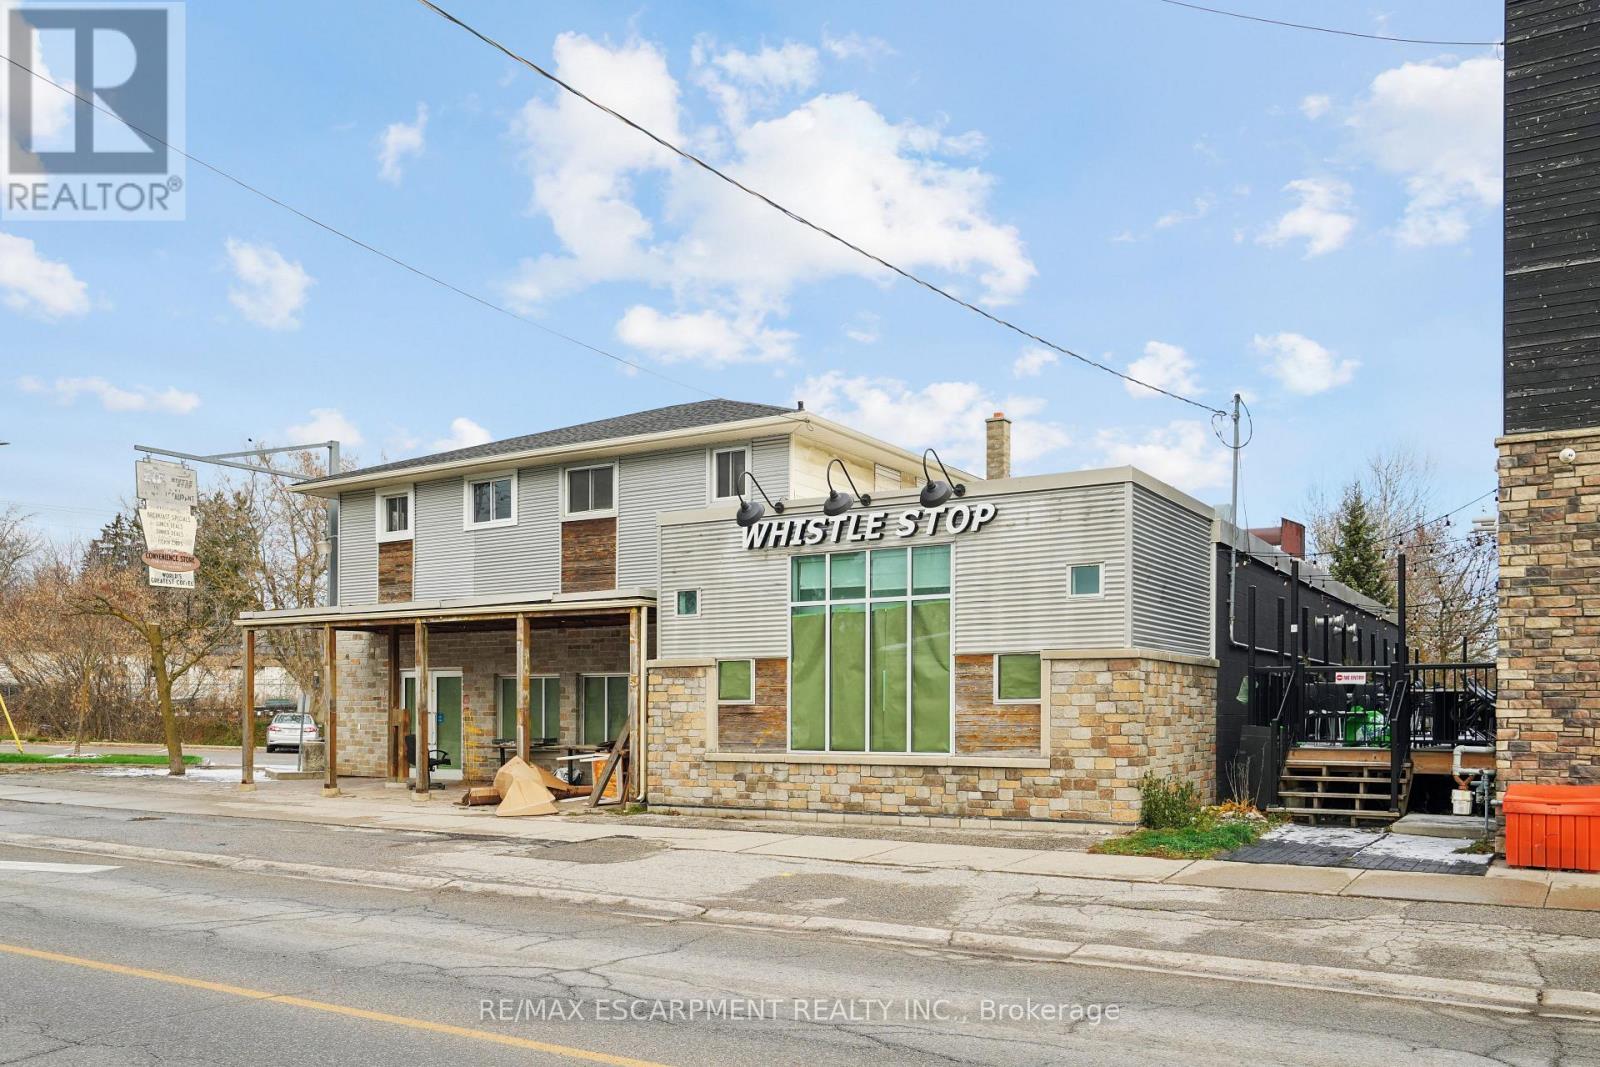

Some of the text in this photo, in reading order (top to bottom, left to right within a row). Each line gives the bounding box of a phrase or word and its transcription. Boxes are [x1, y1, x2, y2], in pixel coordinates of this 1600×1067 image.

[742, 502, 998, 550] WHISTLE STOP
[145, 552, 179, 562] CONVENIENCE
[150, 577, 174, 585] GREATEST
